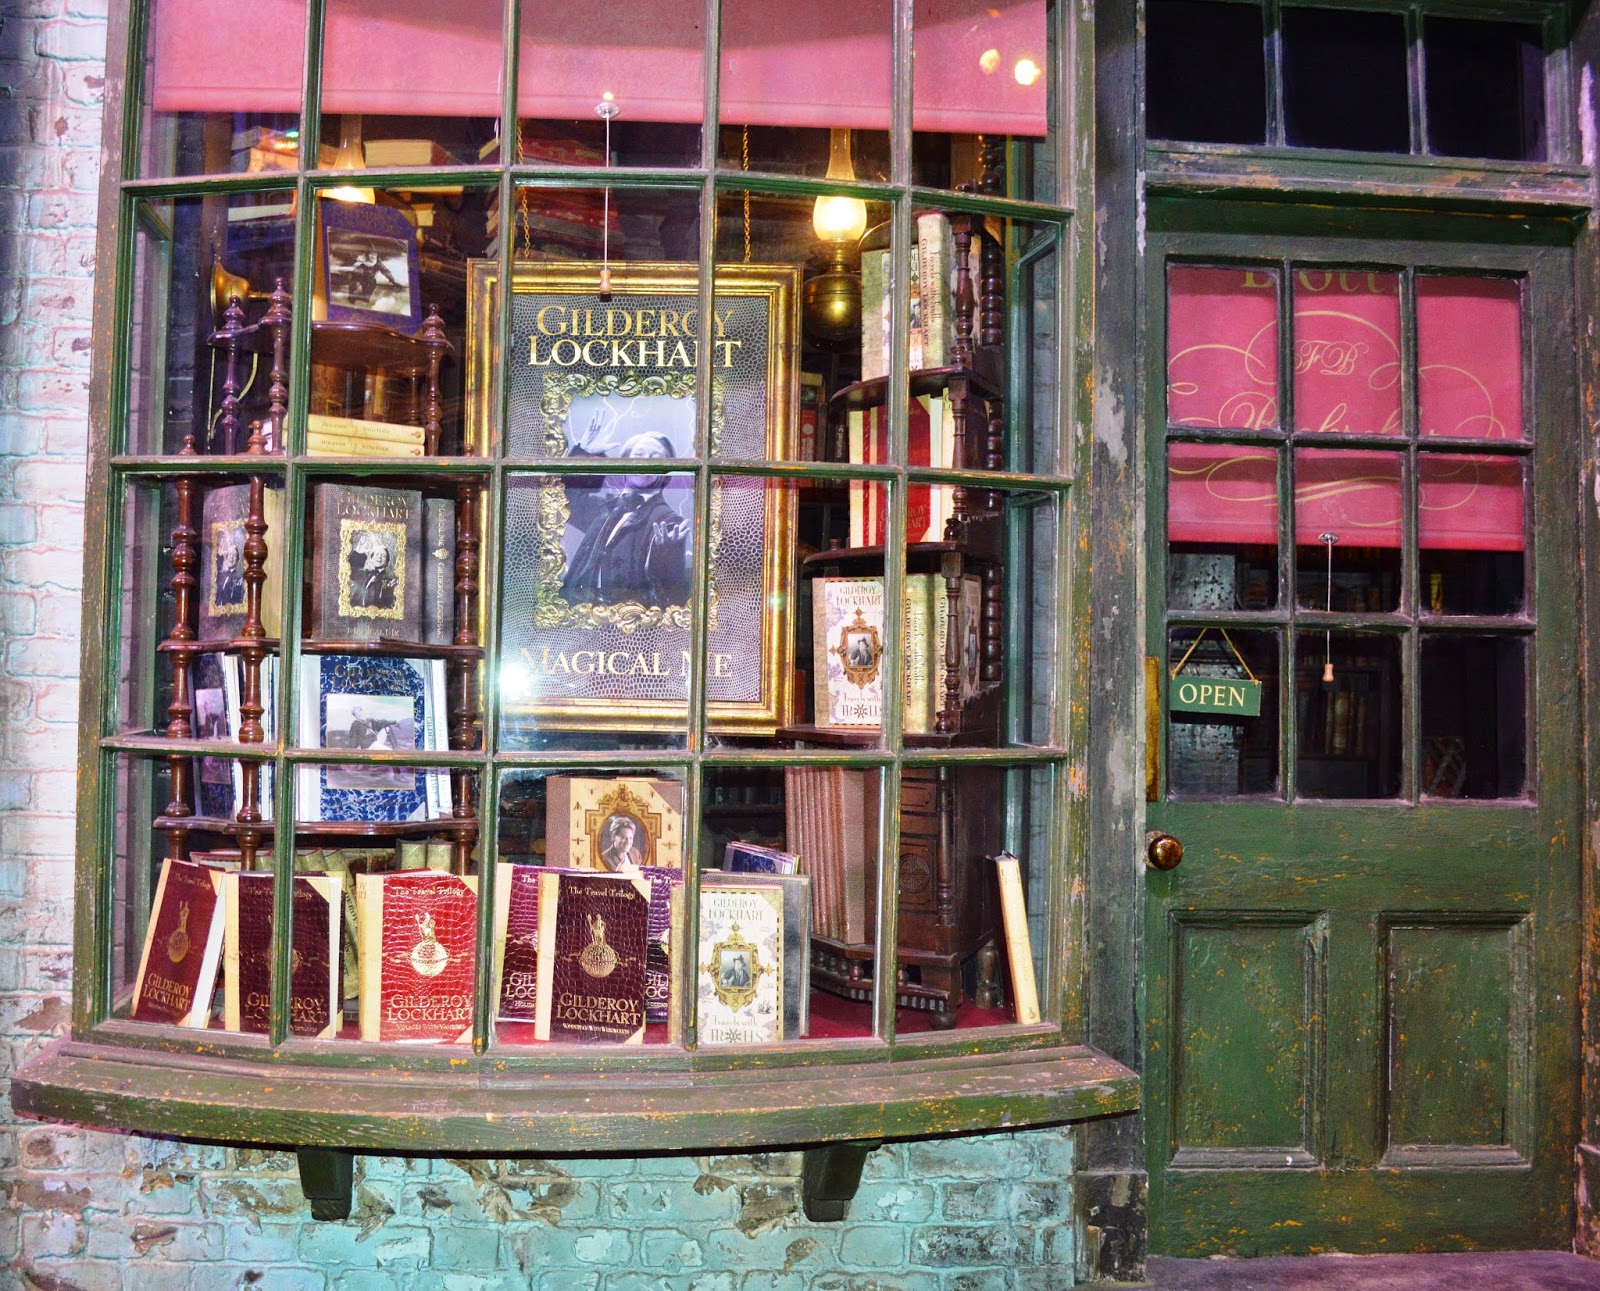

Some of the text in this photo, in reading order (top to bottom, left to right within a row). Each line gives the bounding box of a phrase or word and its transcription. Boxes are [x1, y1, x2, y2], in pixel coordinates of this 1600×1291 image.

[528, 335, 741, 368] LOCKHAT
[521, 647, 670, 677] MAGICAL
[1179, 683, 1246, 708] OPEN
[568, 884, 635, 900] The Travel Trilogy
[147, 972, 192, 999] GILDEROY
[142, 984, 191, 1012] LOCKHART
[247, 991, 326, 1011] GILROY
[390, 993, 473, 1009] GILDEROY
[560, 992, 639, 1012] GILDEROY
[244, 1004, 328, 1024] LOHART
[387, 1006, 474, 1021] LOCKHART
[556, 1004, 641, 1026] LOCKHART
